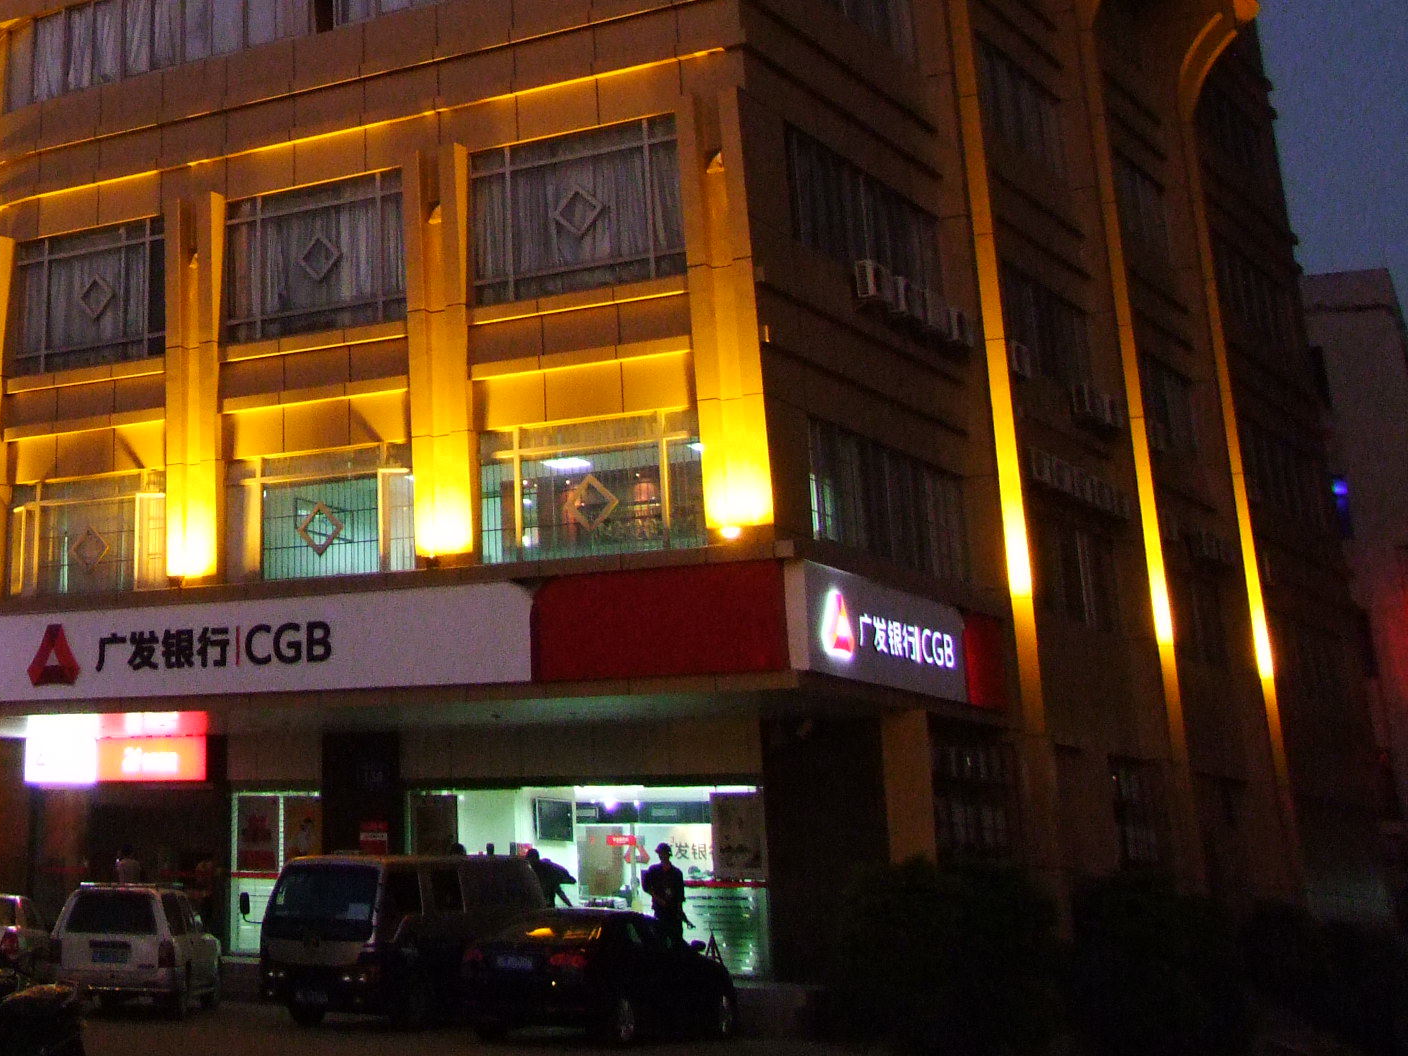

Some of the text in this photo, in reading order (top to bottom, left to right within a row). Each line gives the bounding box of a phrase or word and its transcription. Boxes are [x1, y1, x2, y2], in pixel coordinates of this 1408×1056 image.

[95, 621, 332, 672] 广发银行 CGB
[858, 613, 954, 668] 广发银行 CGB
